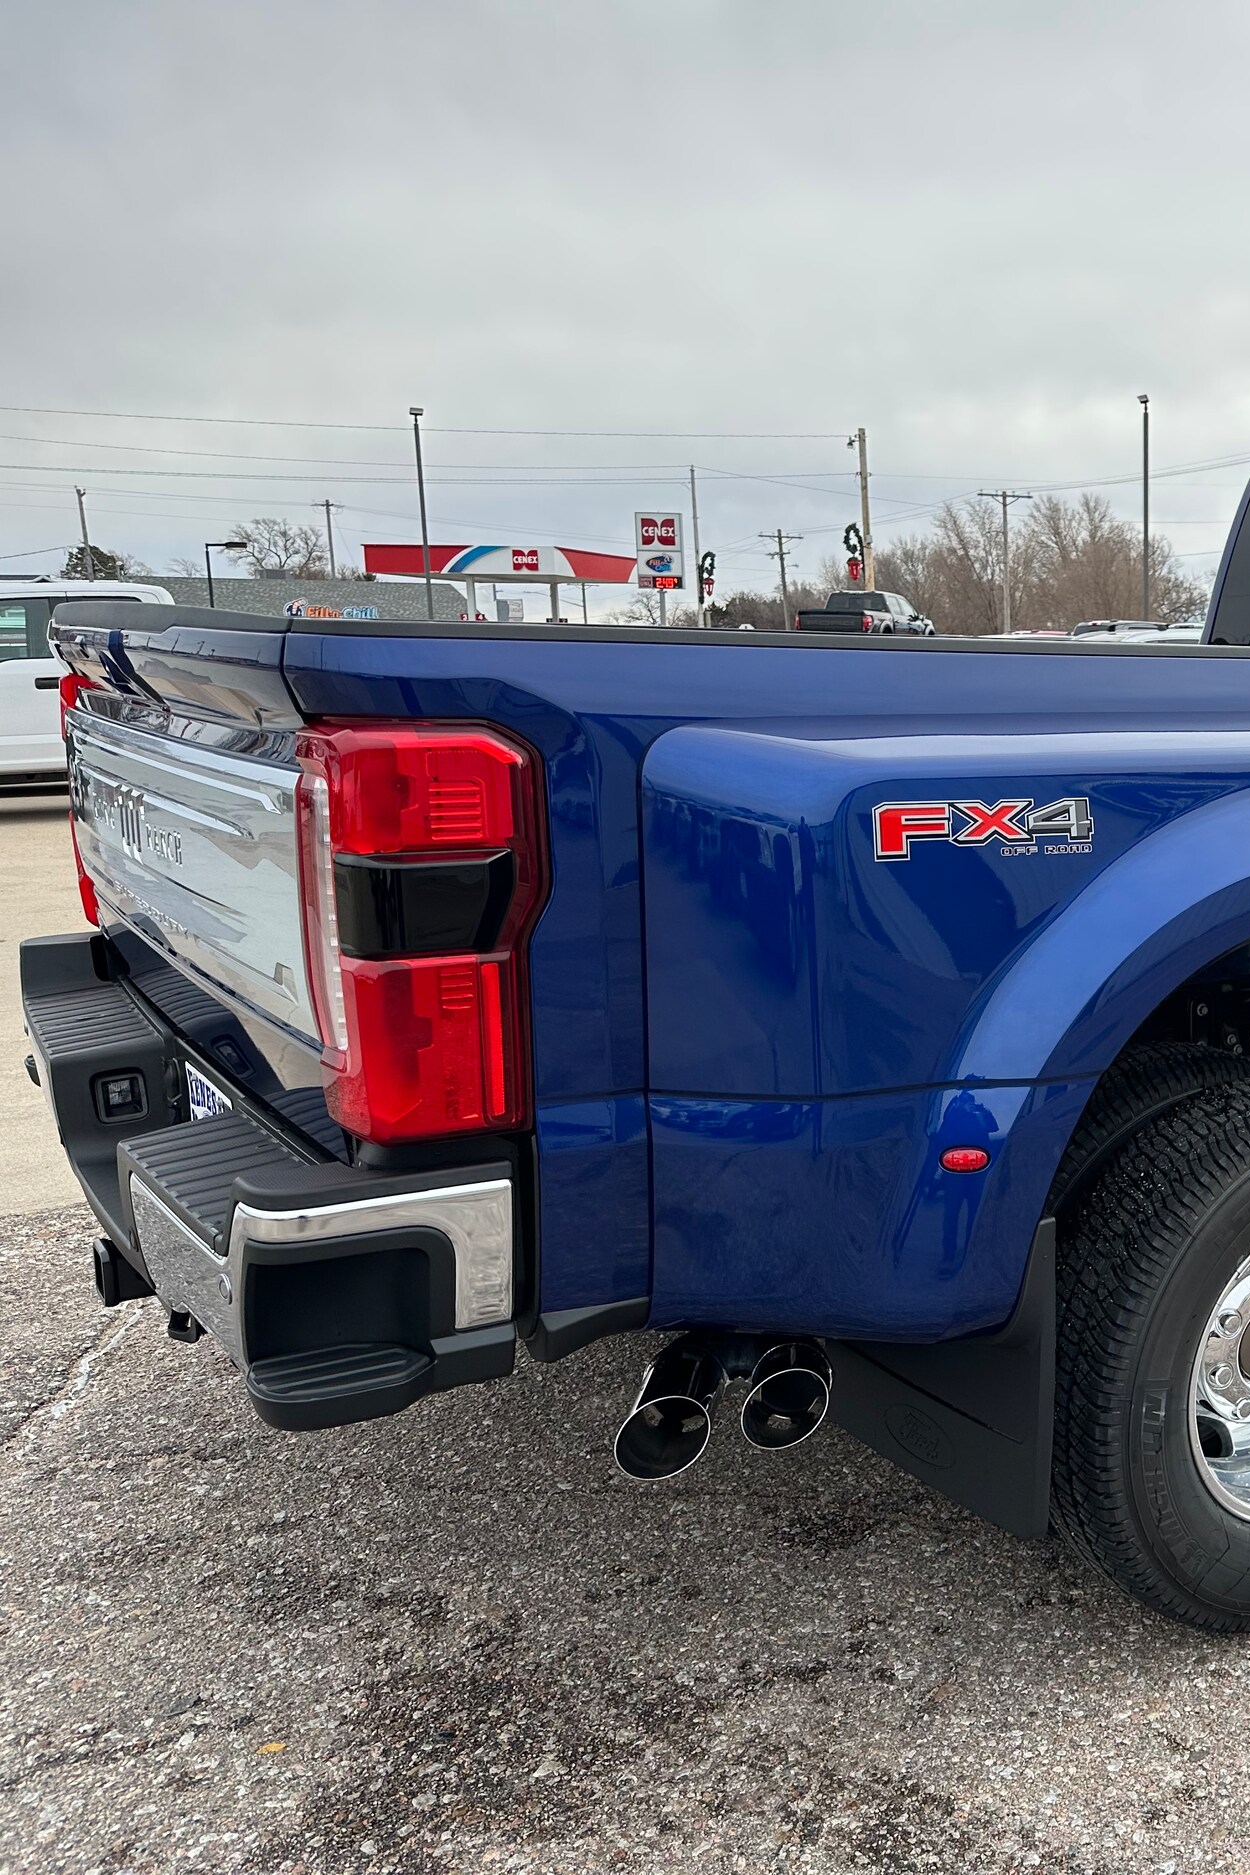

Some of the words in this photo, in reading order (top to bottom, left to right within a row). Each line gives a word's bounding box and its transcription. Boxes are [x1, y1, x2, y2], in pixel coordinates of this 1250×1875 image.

[642, 526, 675, 537] CENEX
[513, 556, 538, 564] CENEX
[145, 822, 183, 867] RANCH
[872, 798, 1094, 862] FX4
[1001, 845, 1038, 857] OFF
[1045, 843, 1093, 856] ROAD
[1142, 1392, 1187, 1547] MICHELIN
